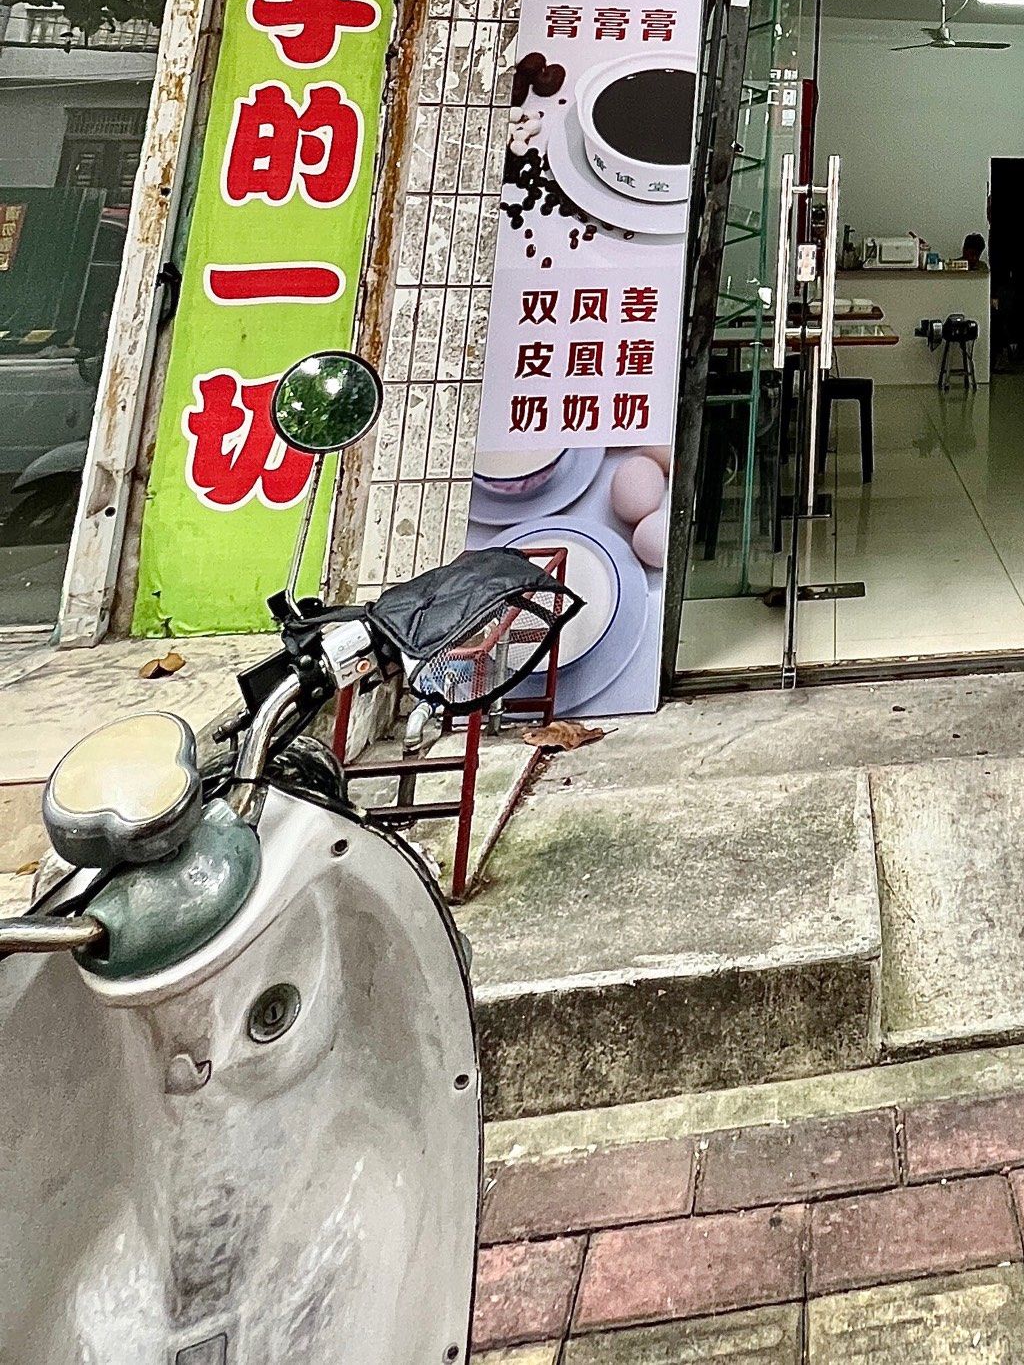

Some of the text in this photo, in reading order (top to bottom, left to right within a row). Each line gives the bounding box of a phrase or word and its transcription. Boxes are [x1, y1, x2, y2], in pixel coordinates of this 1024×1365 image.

[509, 290, 559, 433] 双皮奶
[561, 288, 610, 432] 凤凰奶
[611, 286, 659, 430] 姜撞奶
